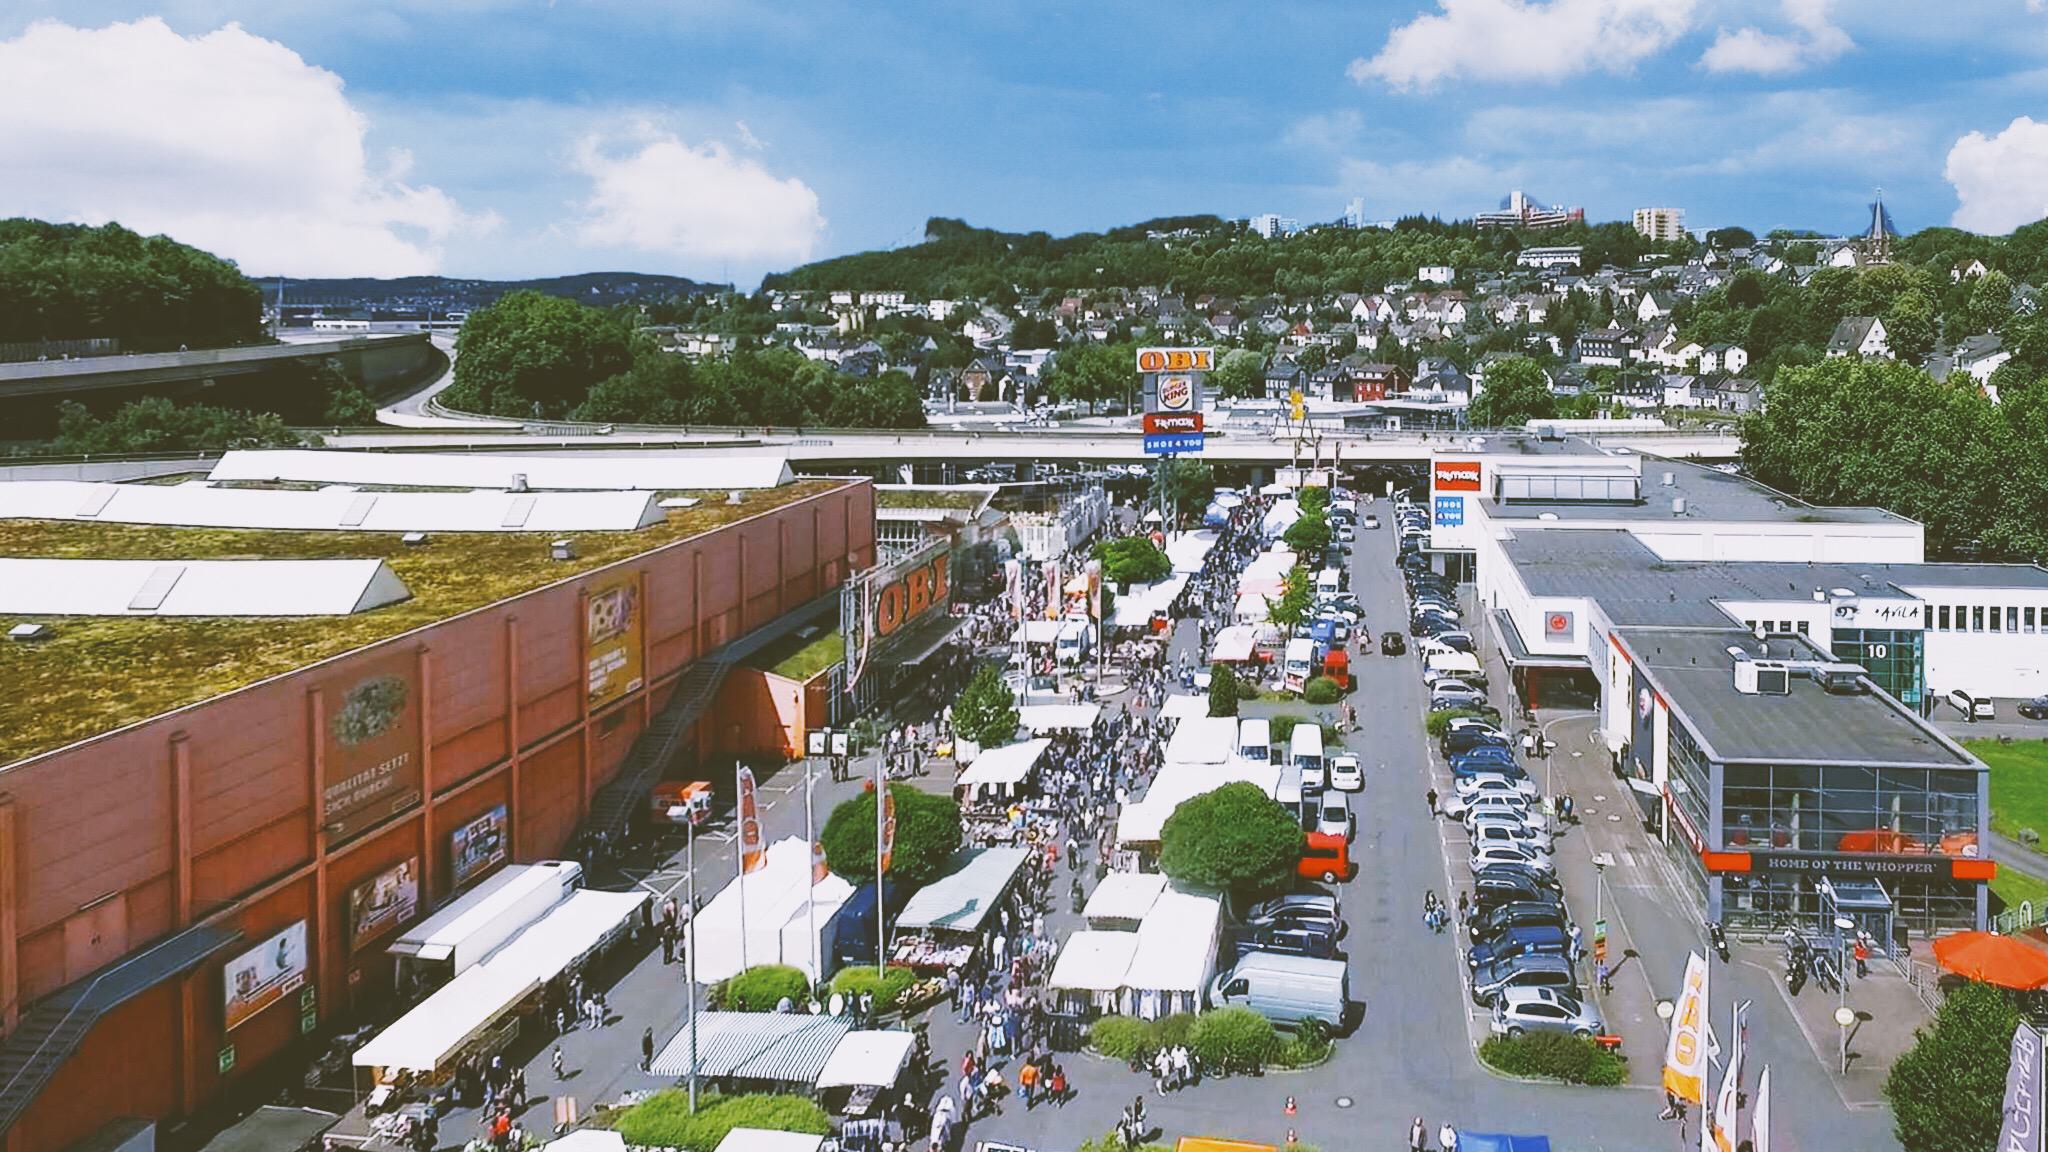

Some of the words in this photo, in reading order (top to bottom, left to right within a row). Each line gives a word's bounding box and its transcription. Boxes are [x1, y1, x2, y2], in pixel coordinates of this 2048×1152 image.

[1140, 351, 1211, 370] OBI
[1164, 386, 1188, 402] KING
[1183, 439, 1202, 447] YOU
[877, 552, 949, 637] OBI
[1868, 643, 1887, 659] 10
[1769, 858, 1809, 869] HOME
[1812, 859, 1831, 870] OF
[1834, 861, 1862, 871] THE
